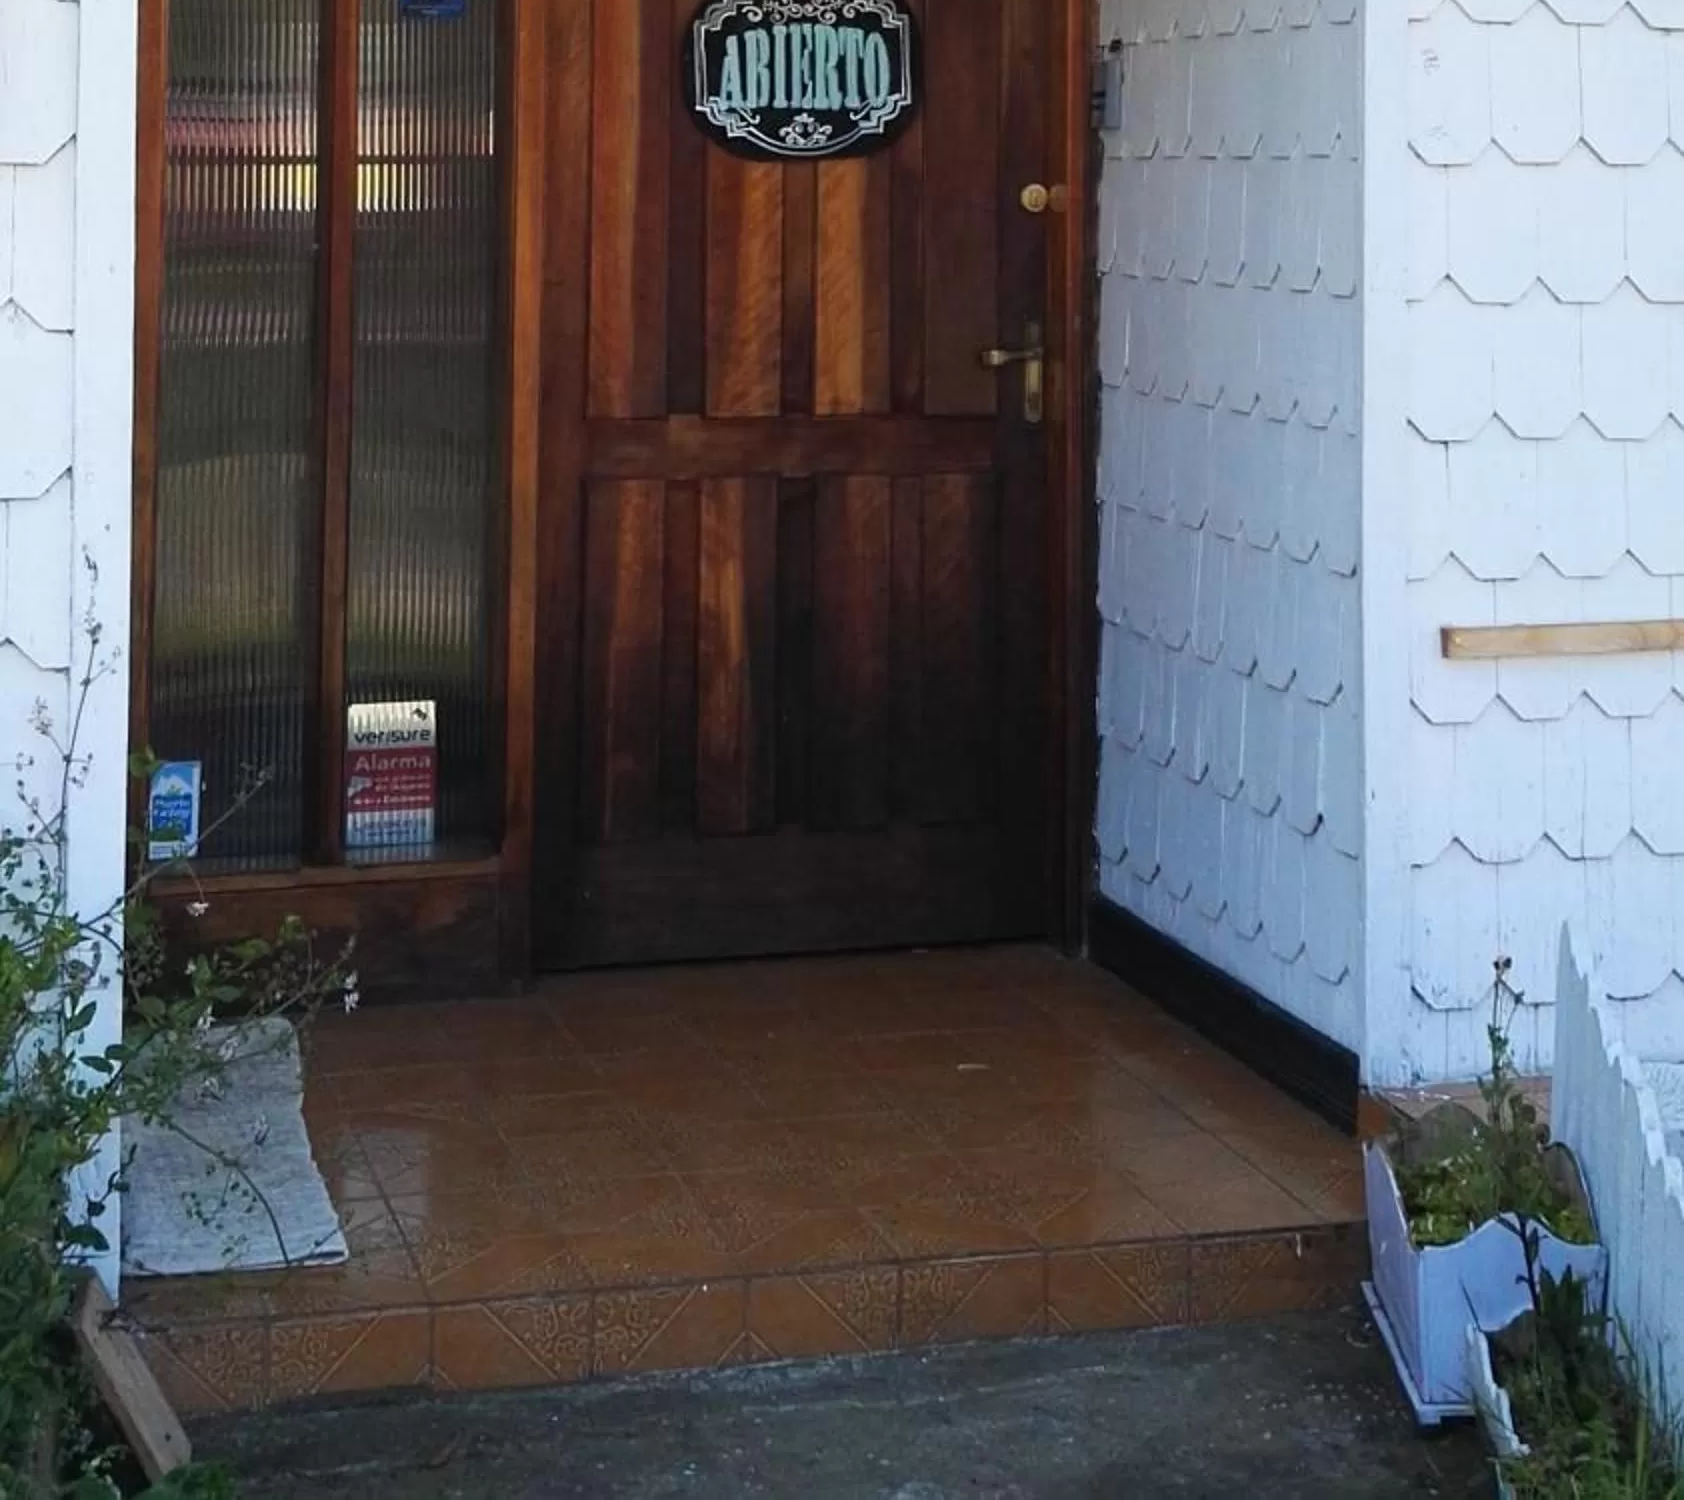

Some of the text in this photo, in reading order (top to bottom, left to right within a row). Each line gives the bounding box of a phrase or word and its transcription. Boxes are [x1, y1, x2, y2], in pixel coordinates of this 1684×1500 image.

[719, 23, 891, 111] ABIERTO
[354, 728, 431, 745] verisure
[354, 753, 432, 771] Alarma
